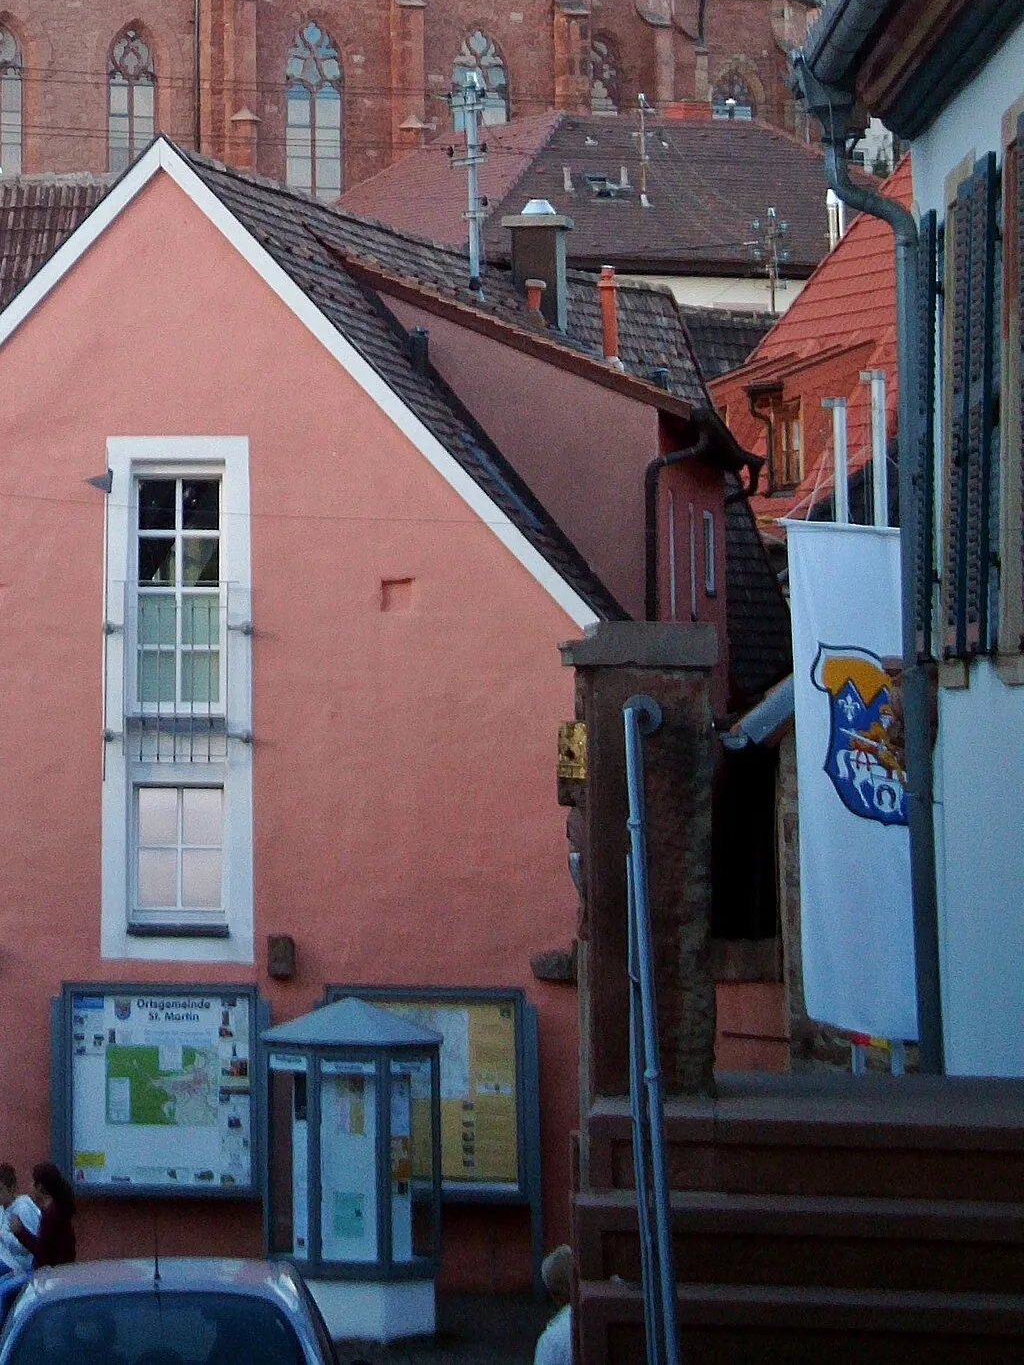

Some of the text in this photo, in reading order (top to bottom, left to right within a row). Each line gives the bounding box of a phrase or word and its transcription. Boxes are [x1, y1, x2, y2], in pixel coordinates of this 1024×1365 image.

[136, 998, 211, 1010] Ortsgemeinde
[148, 1011, 200, 1022] St. Martin
